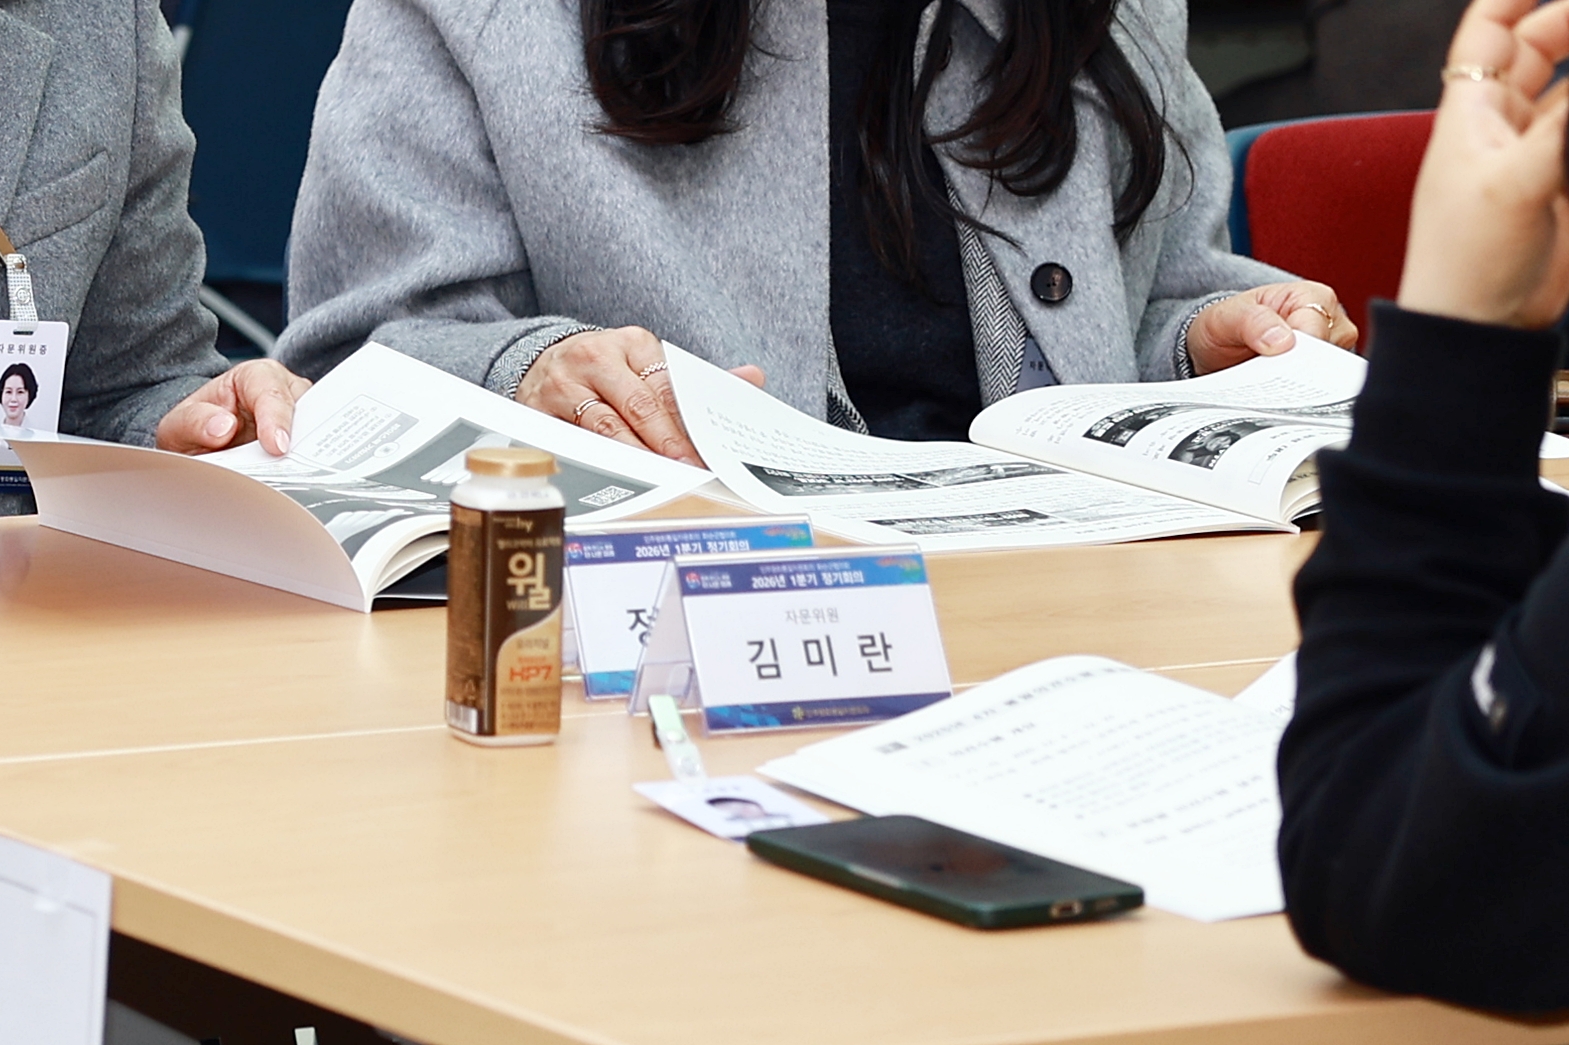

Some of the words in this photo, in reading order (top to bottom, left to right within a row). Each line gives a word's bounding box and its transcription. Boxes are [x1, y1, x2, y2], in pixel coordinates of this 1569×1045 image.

[517, 517, 533, 533] hy
[635, 545, 671, 558] 2026년
[675, 542, 703, 555] 1분기
[707, 540, 750, 553] 정기회의
[506, 552, 551, 610] 윌
[751, 575, 787, 589] 2026년
[790, 573, 818, 587] 1분기
[822, 570, 865, 585] 정기회의
[785, 607, 840, 625] 자문위원
[510, 665, 552, 682] HP7
